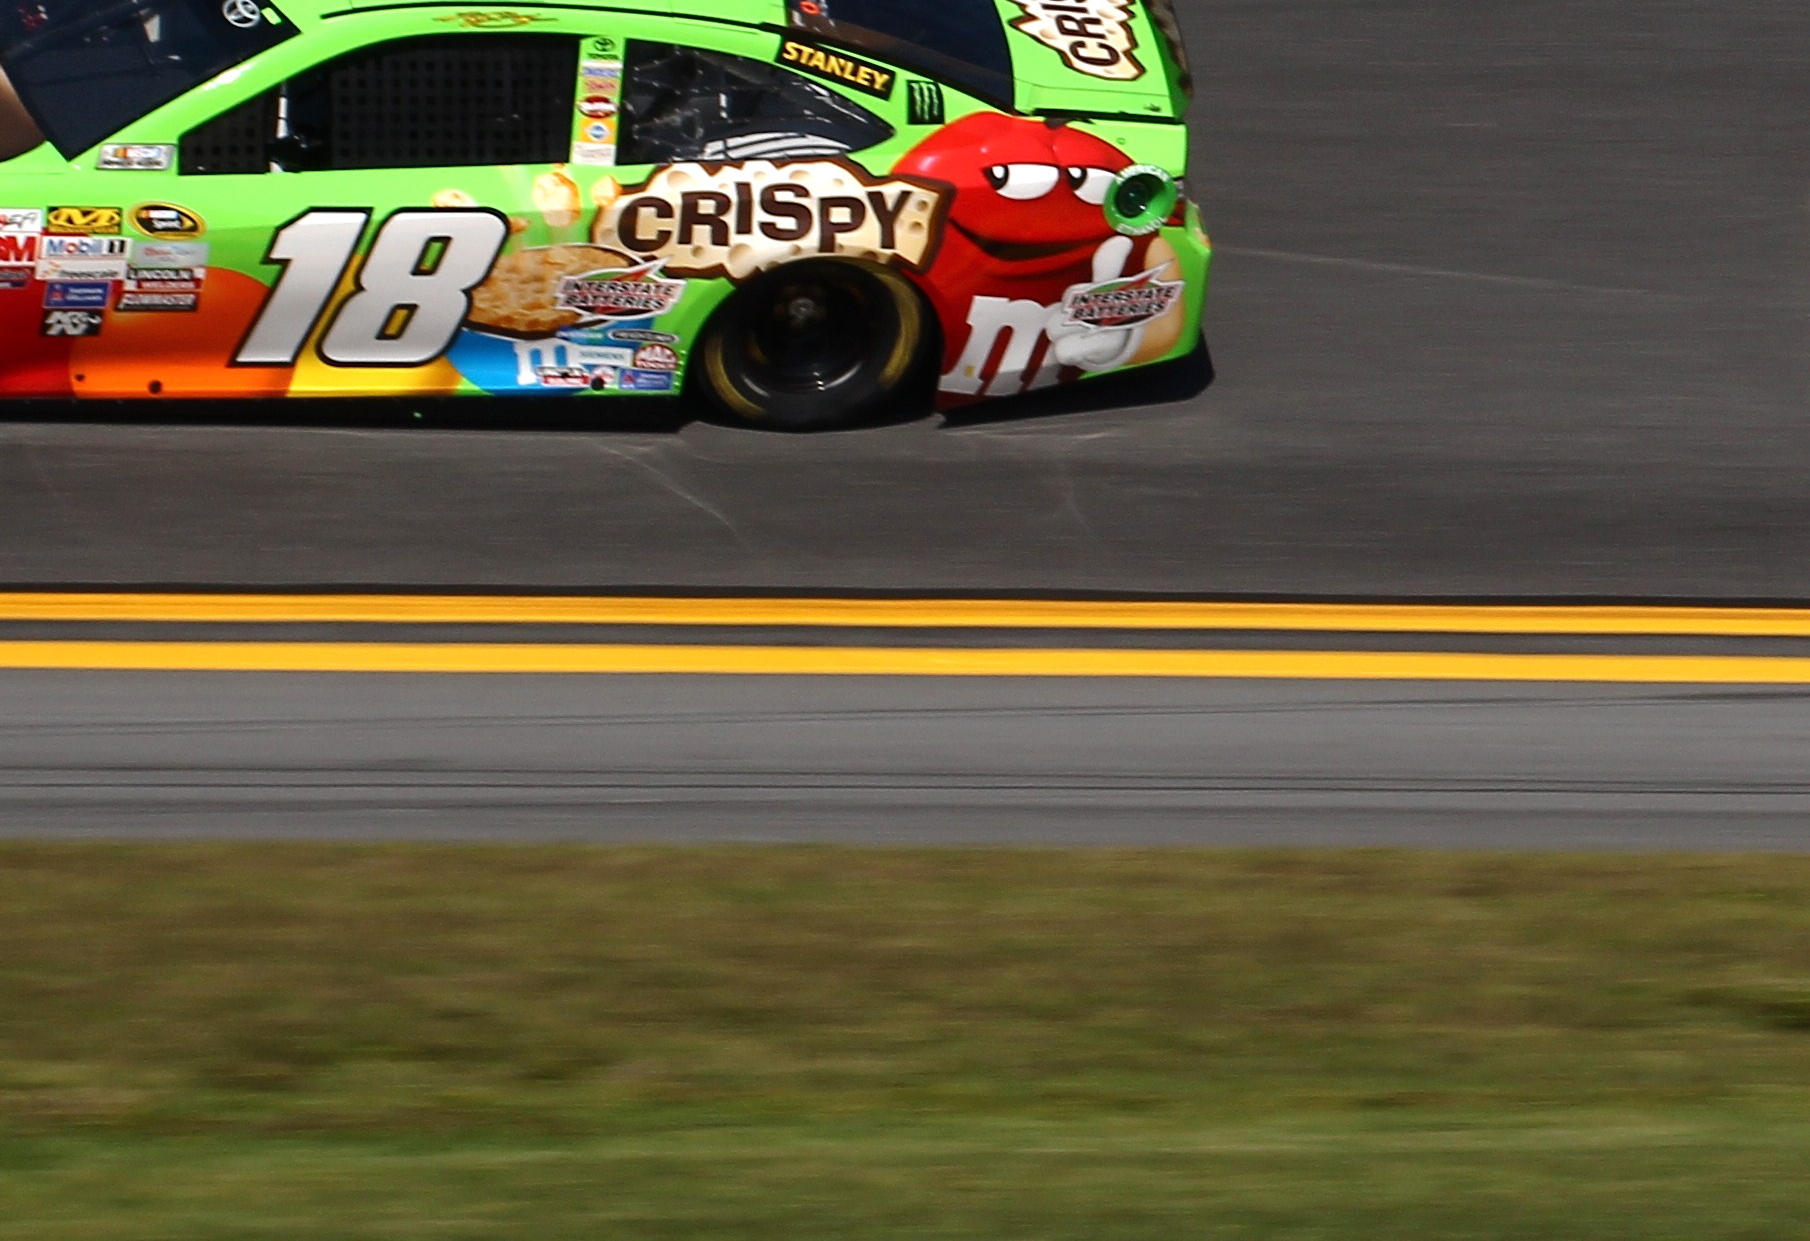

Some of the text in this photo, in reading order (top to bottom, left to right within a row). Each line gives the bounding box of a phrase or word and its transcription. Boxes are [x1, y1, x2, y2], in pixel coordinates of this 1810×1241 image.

[782, 41, 890, 91] STANLEY
[617, 181, 912, 254] CRISPY
[47, 239, 104, 255] Mobil
[128, 269, 193, 280] LINCOLN
[225, 206, 511, 368] 18
[564, 280, 677, 296] INTERSTATE
[563, 294, 665, 310] BATTERIES
[1072, 286, 1175, 307] INTERSTATE
[1071, 301, 1167, 319] BATTERIES
